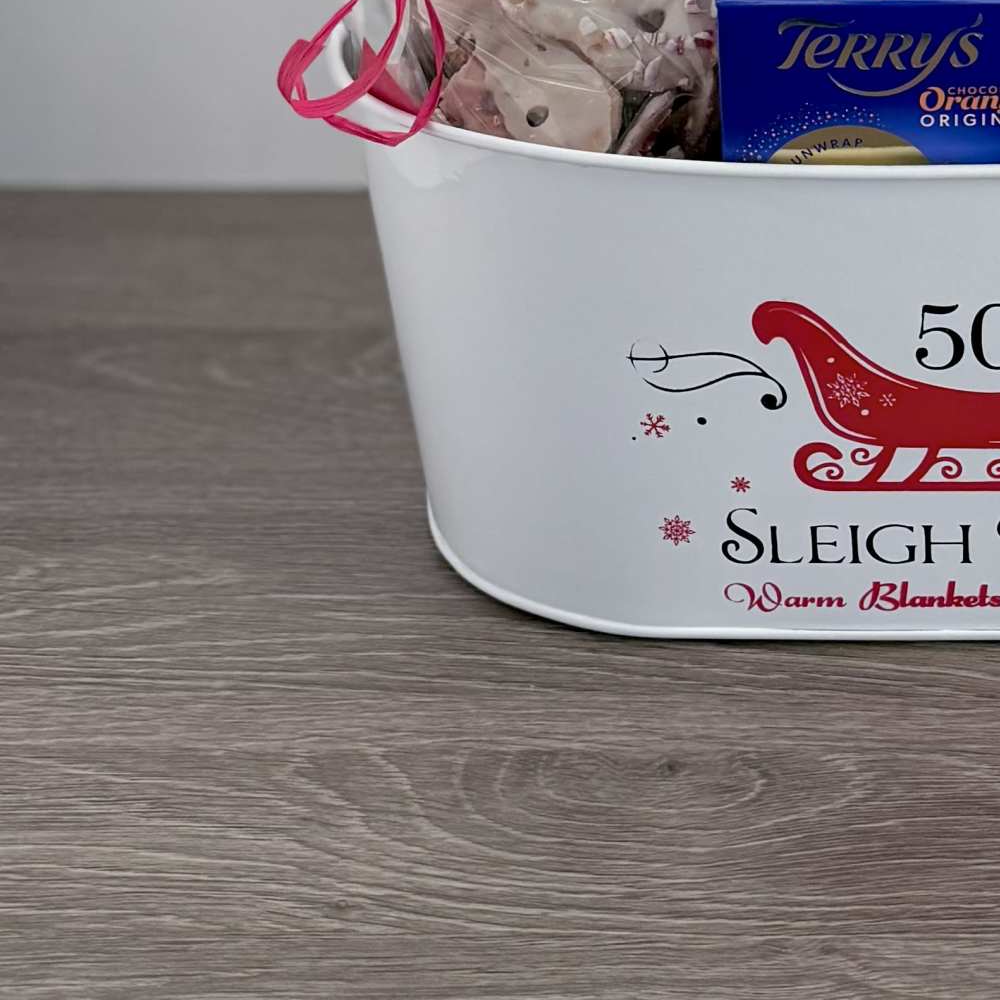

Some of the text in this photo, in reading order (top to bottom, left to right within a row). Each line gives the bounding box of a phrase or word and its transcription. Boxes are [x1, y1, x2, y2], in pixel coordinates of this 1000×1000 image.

[790, 138, 863, 165] UNWRAP
[721, 506, 973, 566] SLEIGH
[723, 581, 848, 612] Warm
